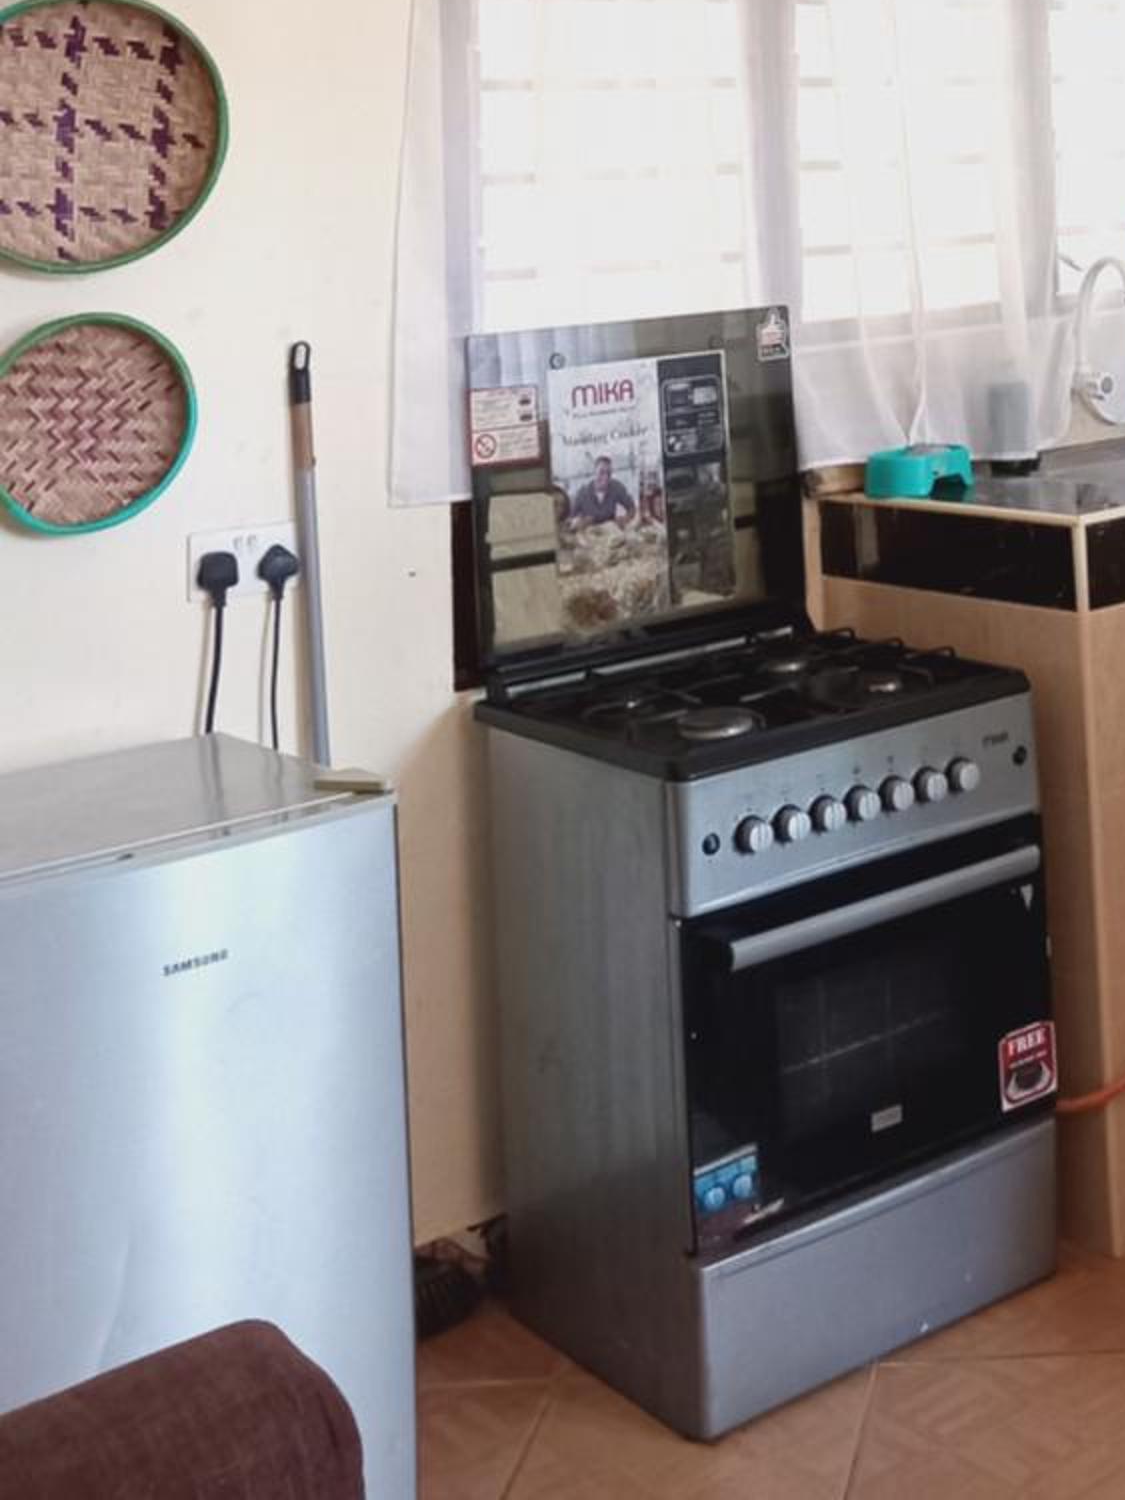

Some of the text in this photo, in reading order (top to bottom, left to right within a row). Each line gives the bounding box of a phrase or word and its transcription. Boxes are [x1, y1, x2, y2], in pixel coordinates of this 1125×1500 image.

[571, 379, 635, 409] MIKA
[163, 948, 228, 976] SAMSUNG
[1008, 1027, 1047, 1056] FREE
